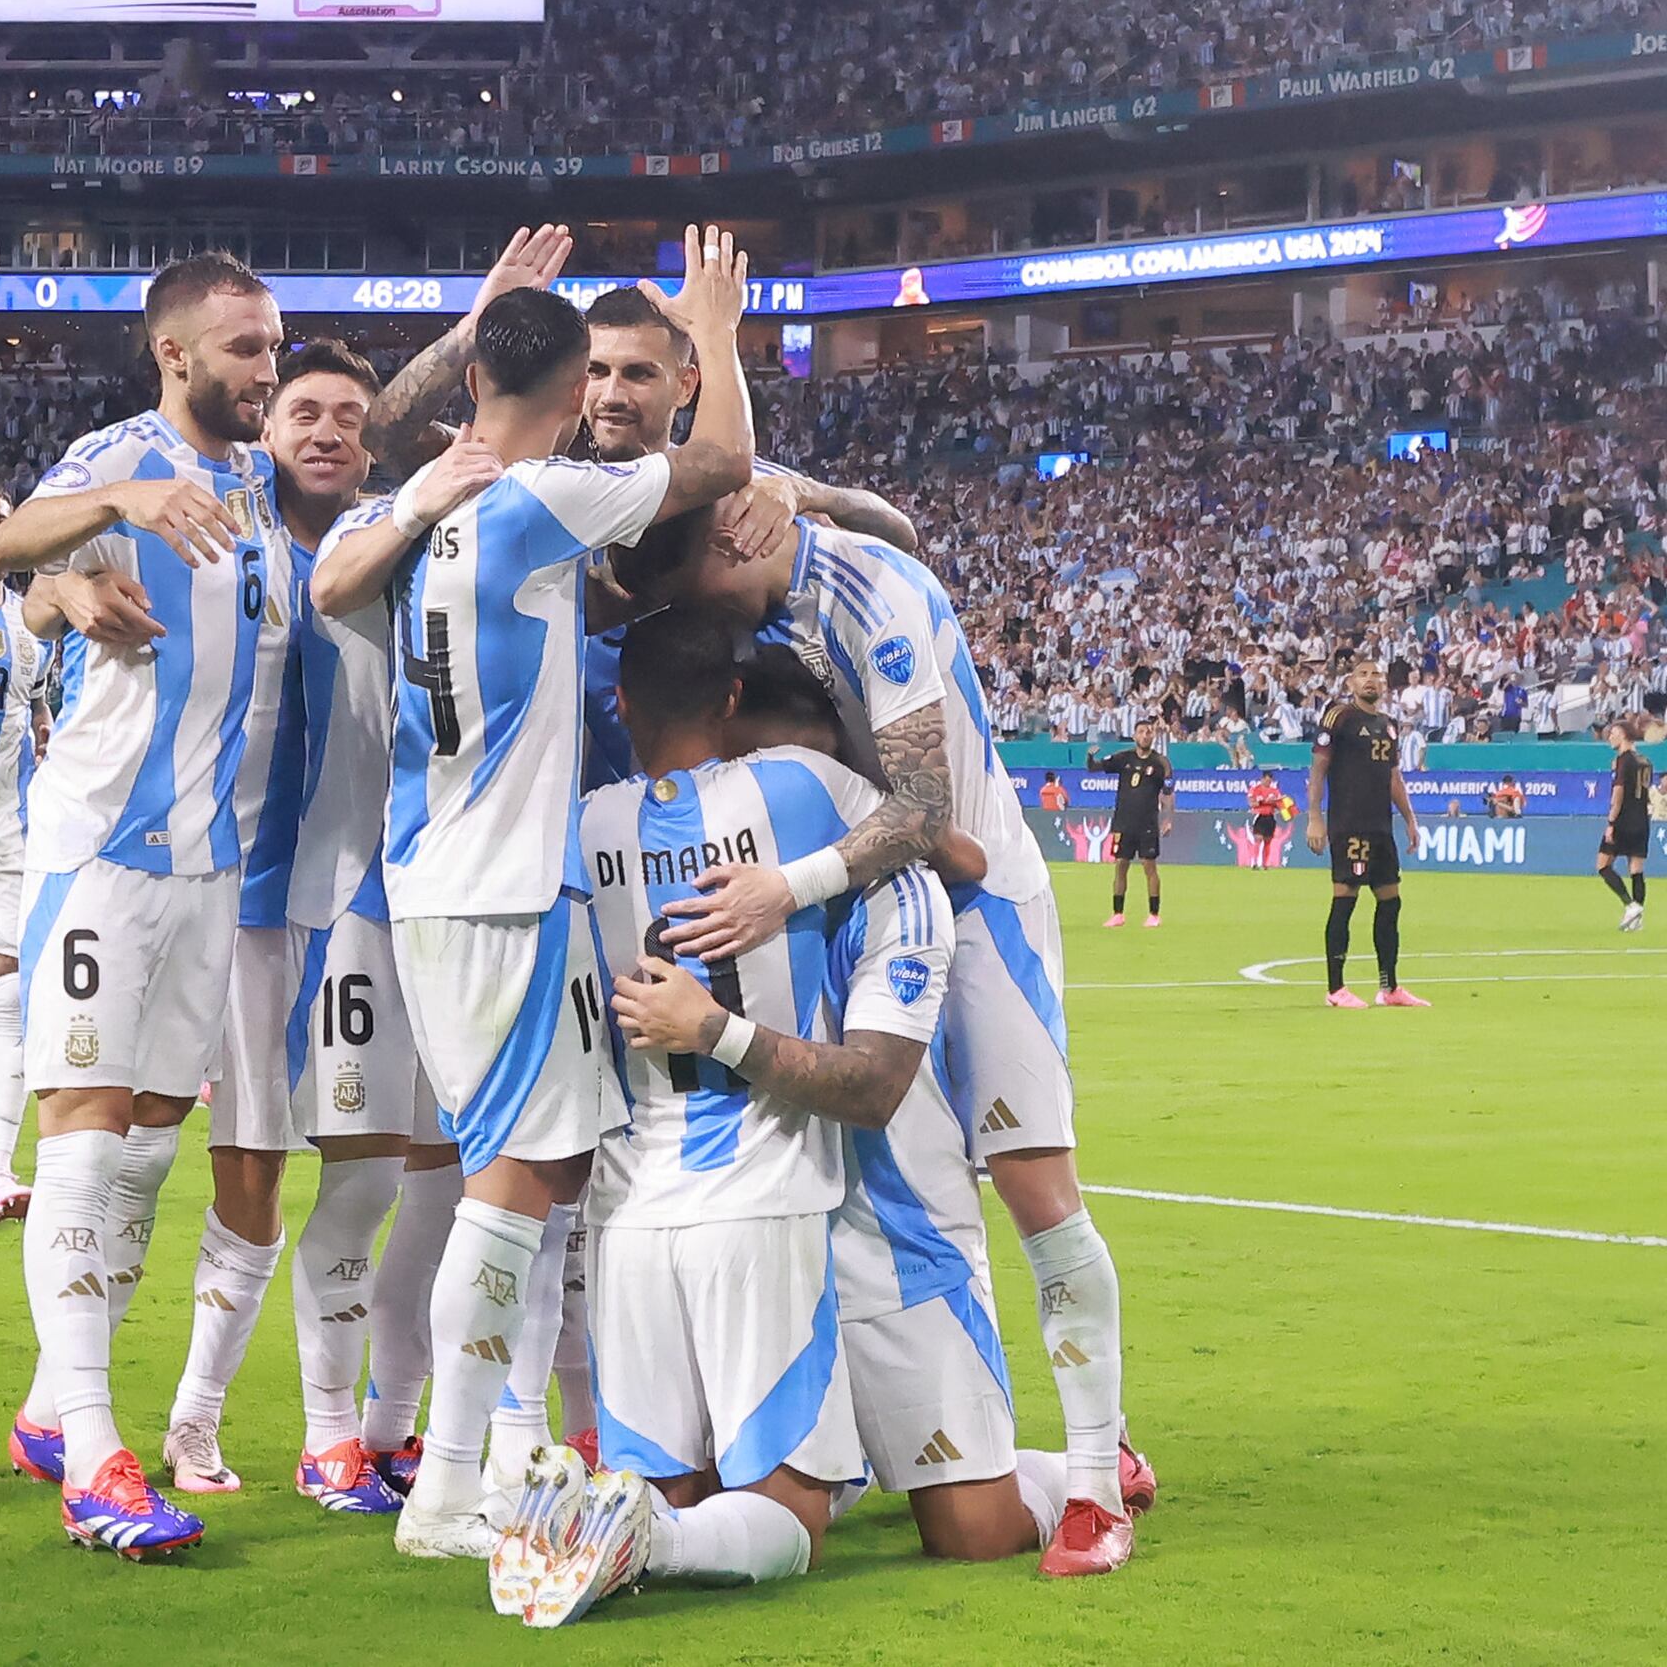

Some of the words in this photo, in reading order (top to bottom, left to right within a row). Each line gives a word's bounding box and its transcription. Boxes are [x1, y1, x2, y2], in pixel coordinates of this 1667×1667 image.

[1278, 78, 1324, 99] PAUL
[1327, 66, 1420, 94] WARFIELD
[1427, 57, 1456, 80] 42
[1013, 112, 1044, 133] JIM
[1050, 103, 1118, 130] LANGER
[1132, 94, 1158, 119] 62
[772, 143, 804, 163] BOB
[808, 138, 860, 159] GRIESE
[864, 131, 883, 152] 12
[53, 155, 87, 175] NAT
[94, 156, 166, 175] MOORE
[173, 155, 204, 175] 89
[379, 155, 446, 175] LARRY
[454, 155, 544, 175] CSONKA
[552, 156, 584, 175] 39
[1021, 254, 1133, 287] CONMEBOL
[1132, 247, 1188, 276] COPA
[1187, 238, 1282, 272] AMERICA
[1284, 237, 1327, 262] USA
[1329, 231, 1383, 257] 2024
[34, 277, 58, 308] 0
[352, 280, 443, 309] 46:28
[771, 282, 804, 311] PM
[242, 549, 262, 621] 6
[877, 645, 910, 668] VIBRA
[1371, 738, 1392, 761] 22
[1131, 772, 1141, 788] 8
[1173, 779, 1225, 793] AMERICA
[1525, 781, 1557, 796] 2024
[595, 849, 626, 888] DI
[641, 827, 759, 885] MARIA
[1347, 837, 1370, 861] 22
[1417, 825, 1527, 865] MIAMI
[63, 928, 100, 1001] 6
[892, 967, 926, 983] VIBRA
[323, 973, 374, 1047] 16
[71, 1036, 93, 1057] AFA
[339, 1083, 360, 1103] AFA
[51, 1226, 100, 1254] AFA
